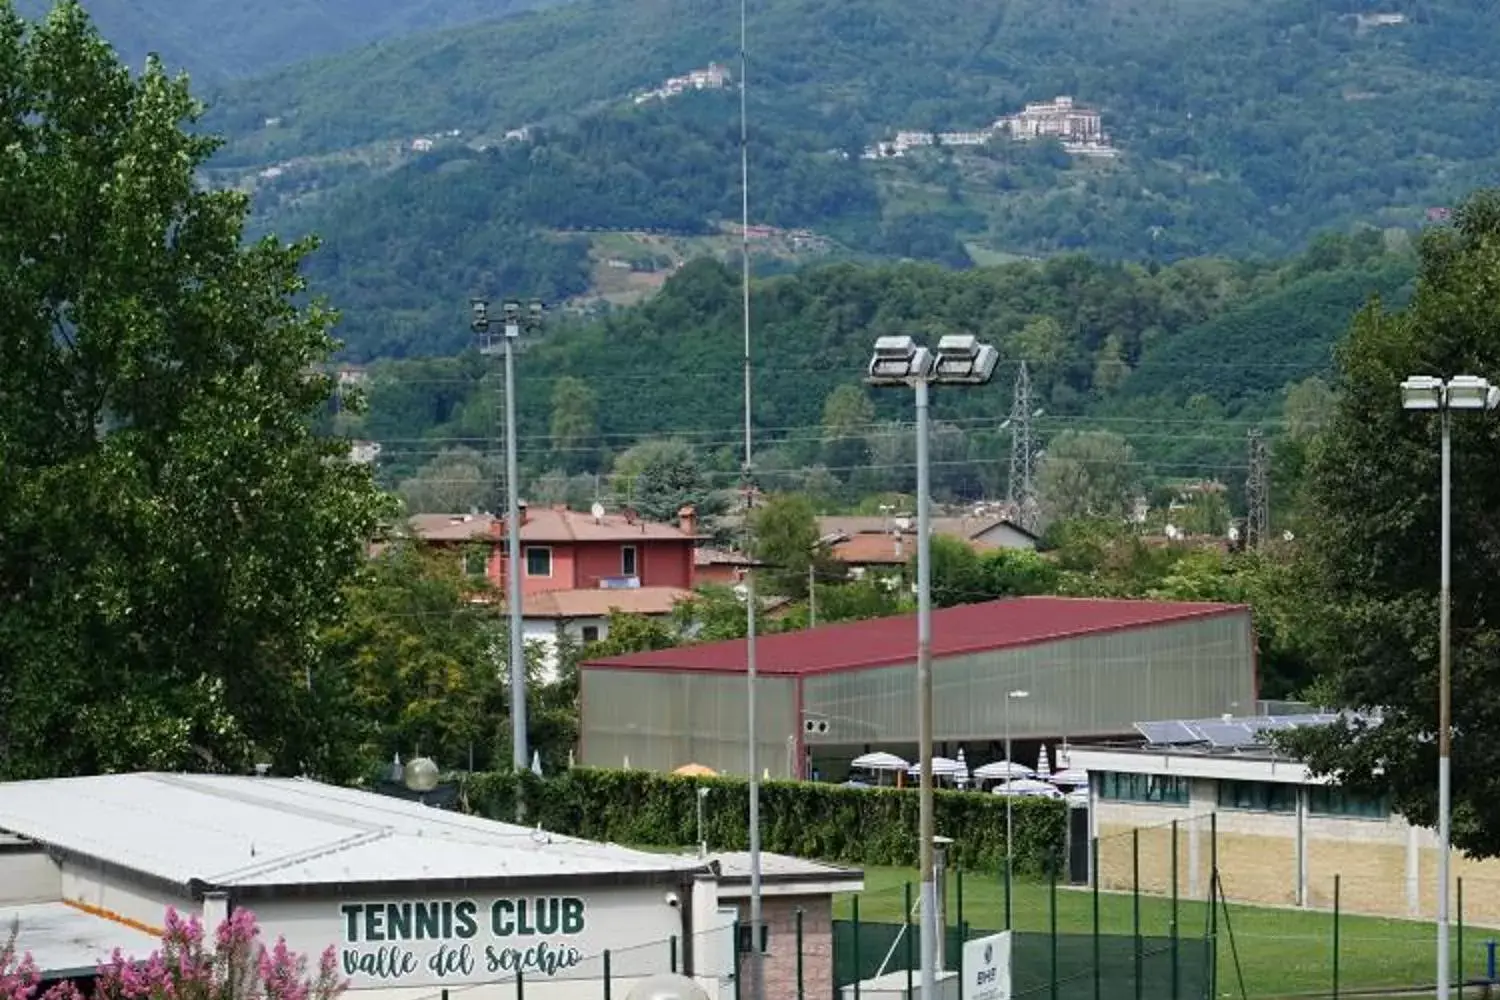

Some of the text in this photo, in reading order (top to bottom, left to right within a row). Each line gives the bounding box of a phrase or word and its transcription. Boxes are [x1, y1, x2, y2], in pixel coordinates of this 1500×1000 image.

[342, 898, 585, 942] TENNIS CLUB
[428, 943, 475, 977] del
